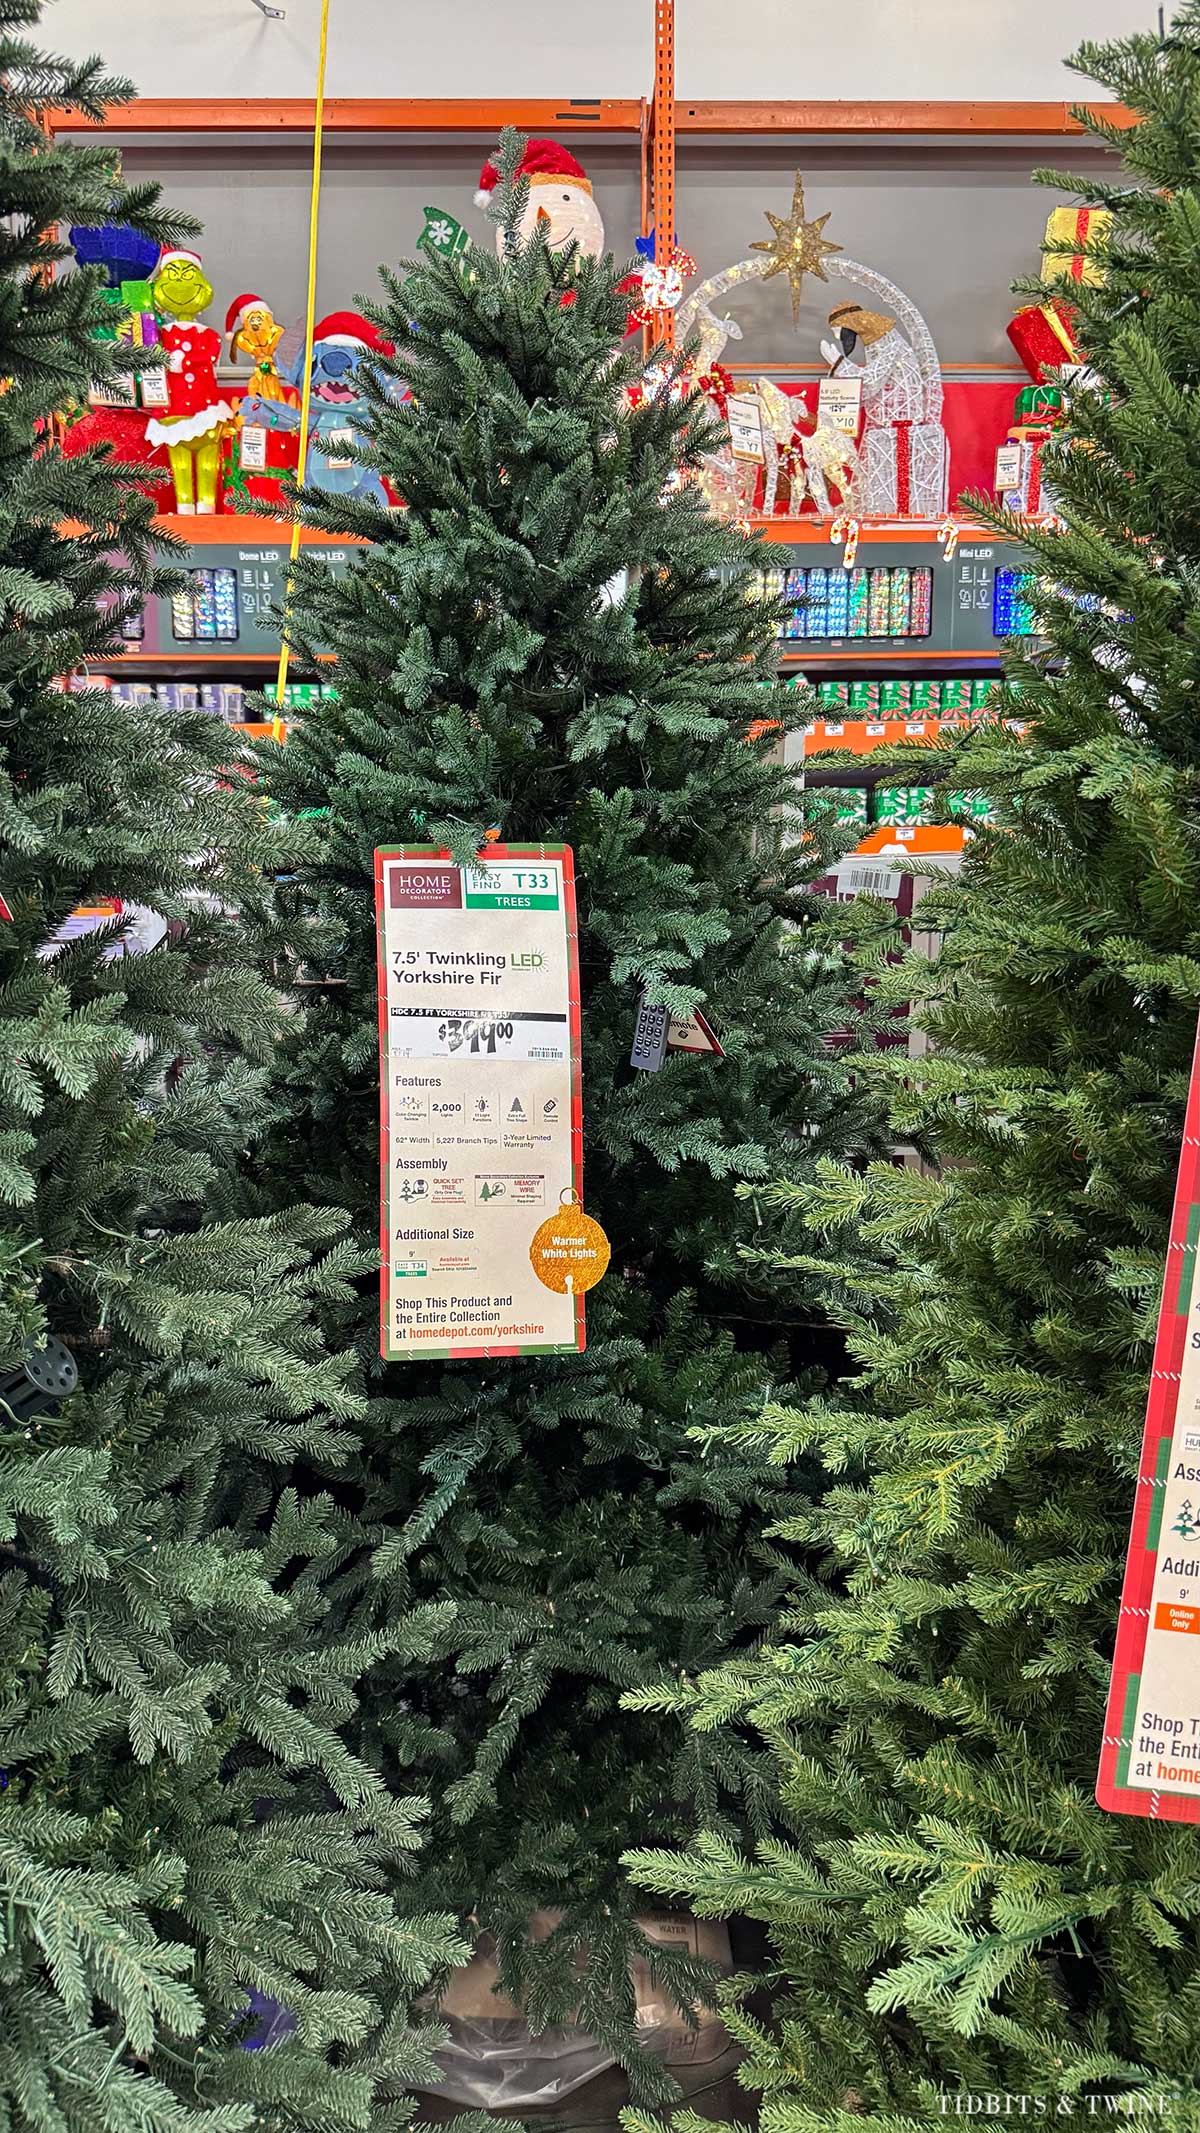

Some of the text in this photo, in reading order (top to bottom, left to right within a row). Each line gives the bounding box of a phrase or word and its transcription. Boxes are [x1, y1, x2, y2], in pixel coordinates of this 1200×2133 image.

[260, 552, 278, 560] LED
[327, 552, 345, 560] LED
[400, 876, 451, 887] HOME
[512, 874, 548, 888] T33
[495, 897, 531, 906] TREES
[392, 952, 543, 968] 7.5' Twinkling LED
[393, 970, 501, 984] Yorkshire Fir
[396, 1076, 441, 1086] Features
[432, 1104, 461, 1113] 2,000
[396, 1158, 448, 1171] Assembly
[396, 1228, 474, 1240] Additional Size
[552, 1236, 587, 1245] Warmer
[542, 1249, 597, 1259] White Lights
[396, 1296, 512, 1311] Shop This Product and
[396, 1311, 500, 1324] the Entire Collection
[396, 1323, 544, 1339] at homedepot.com/yorkshire
[1180, 1589, 1189, 1599] 9'
[1169, 1609, 1194, 1620] Online
[1172, 1619, 1190, 1630] Only
[1142, 1712, 1183, 1736] Shop
[1139, 1736, 1164, 1755] the
[1136, 1761, 1152, 1777] at
[659, 1925, 687, 1934] WATER
